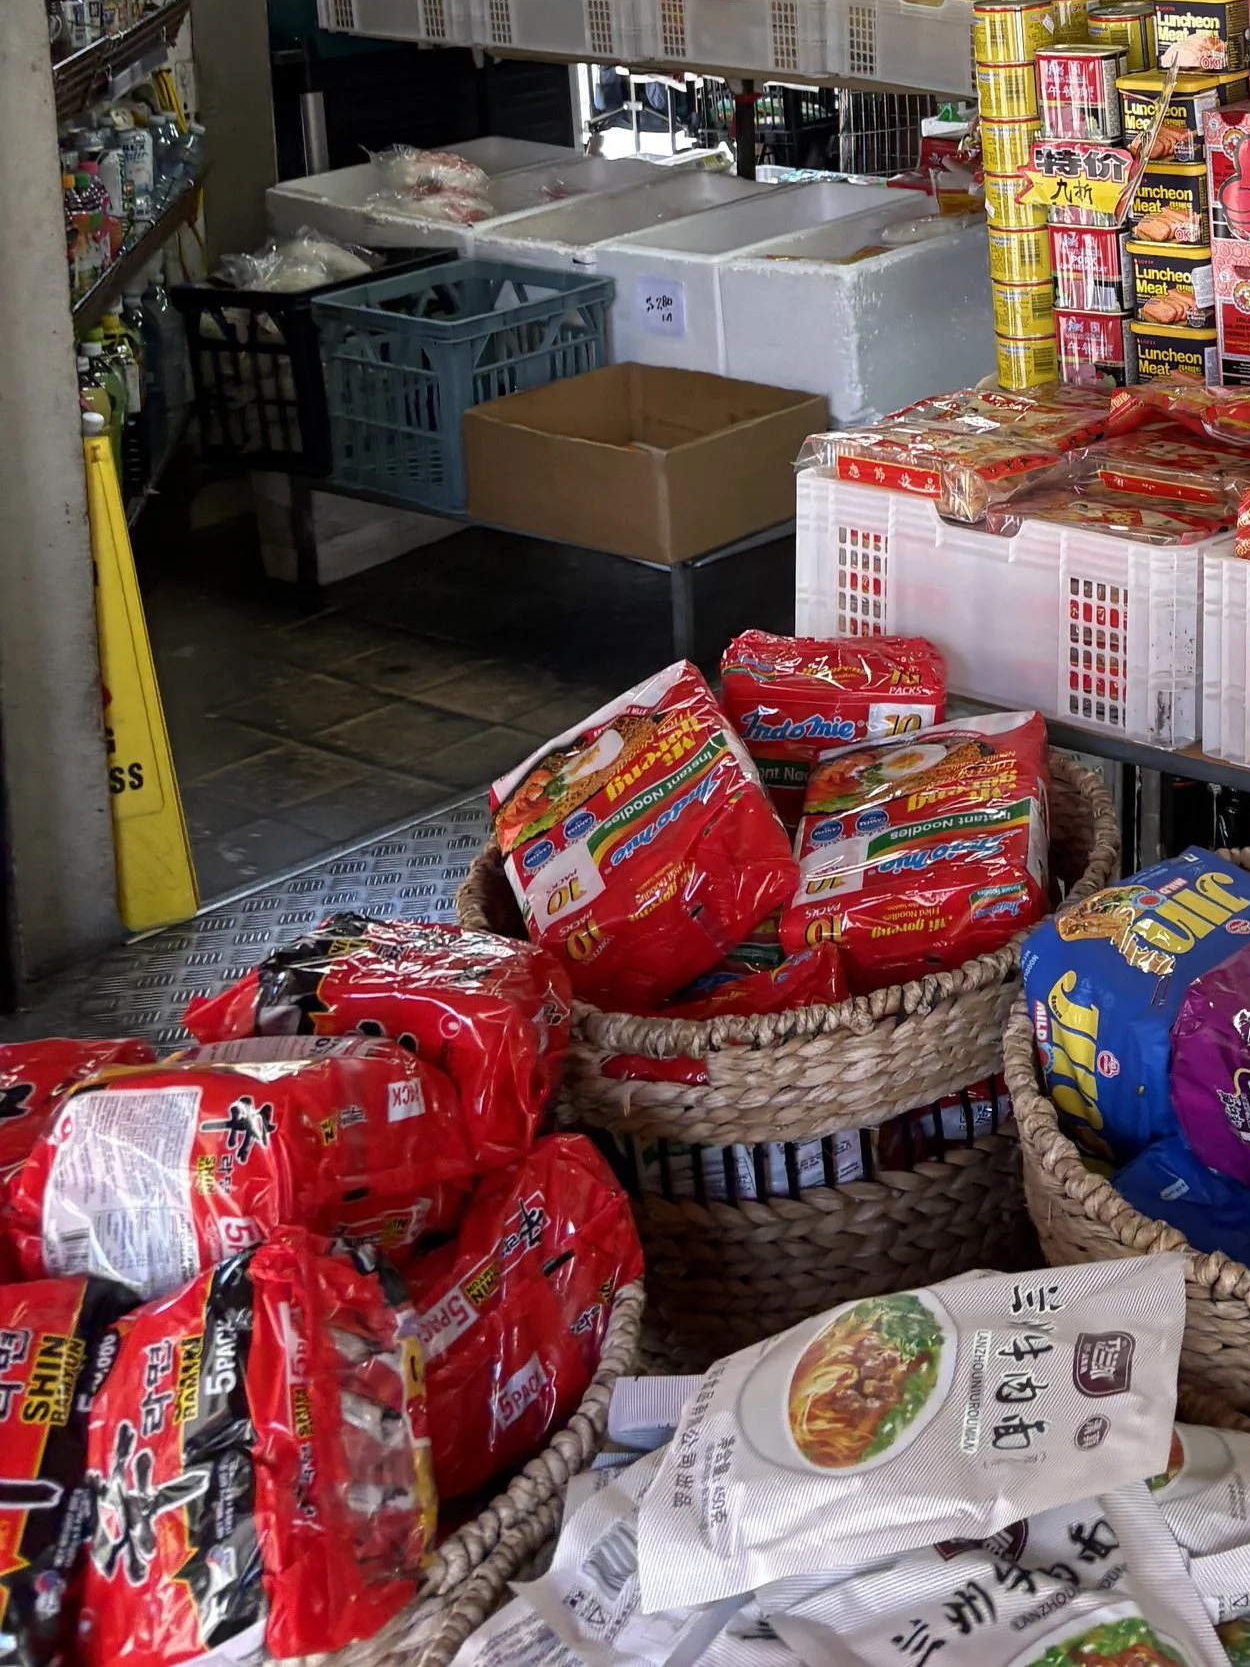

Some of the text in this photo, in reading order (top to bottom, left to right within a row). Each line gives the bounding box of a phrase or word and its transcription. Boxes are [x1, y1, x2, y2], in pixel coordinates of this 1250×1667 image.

[1157, 11, 1220, 29] Luncheon
[1158, 26, 1189, 41] Meat
[1124, 98, 1187, 118] Lunceon
[1035, 148, 1130, 182] 特价
[1050, 179, 1093, 205] 九折
[1134, 185, 1193, 201] uncheon
[1135, 264, 1193, 285] Luncheo
[1136, 279, 1168, 296] Meat
[1138, 345, 1202, 365] Luncheon
[1139, 359, 1170, 376] Meat
[889, 686, 923, 694] PACKS
[670, 751, 713, 790] Instant
[603, 790, 666, 830] Noodles
[890, 818, 954, 840] Noodles
[546, 868, 578, 894] PACKS
[546, 877, 588, 916] 10
[1034, 1001, 1048, 1042] MILD
[22, 1335, 66, 1424] SHIN
